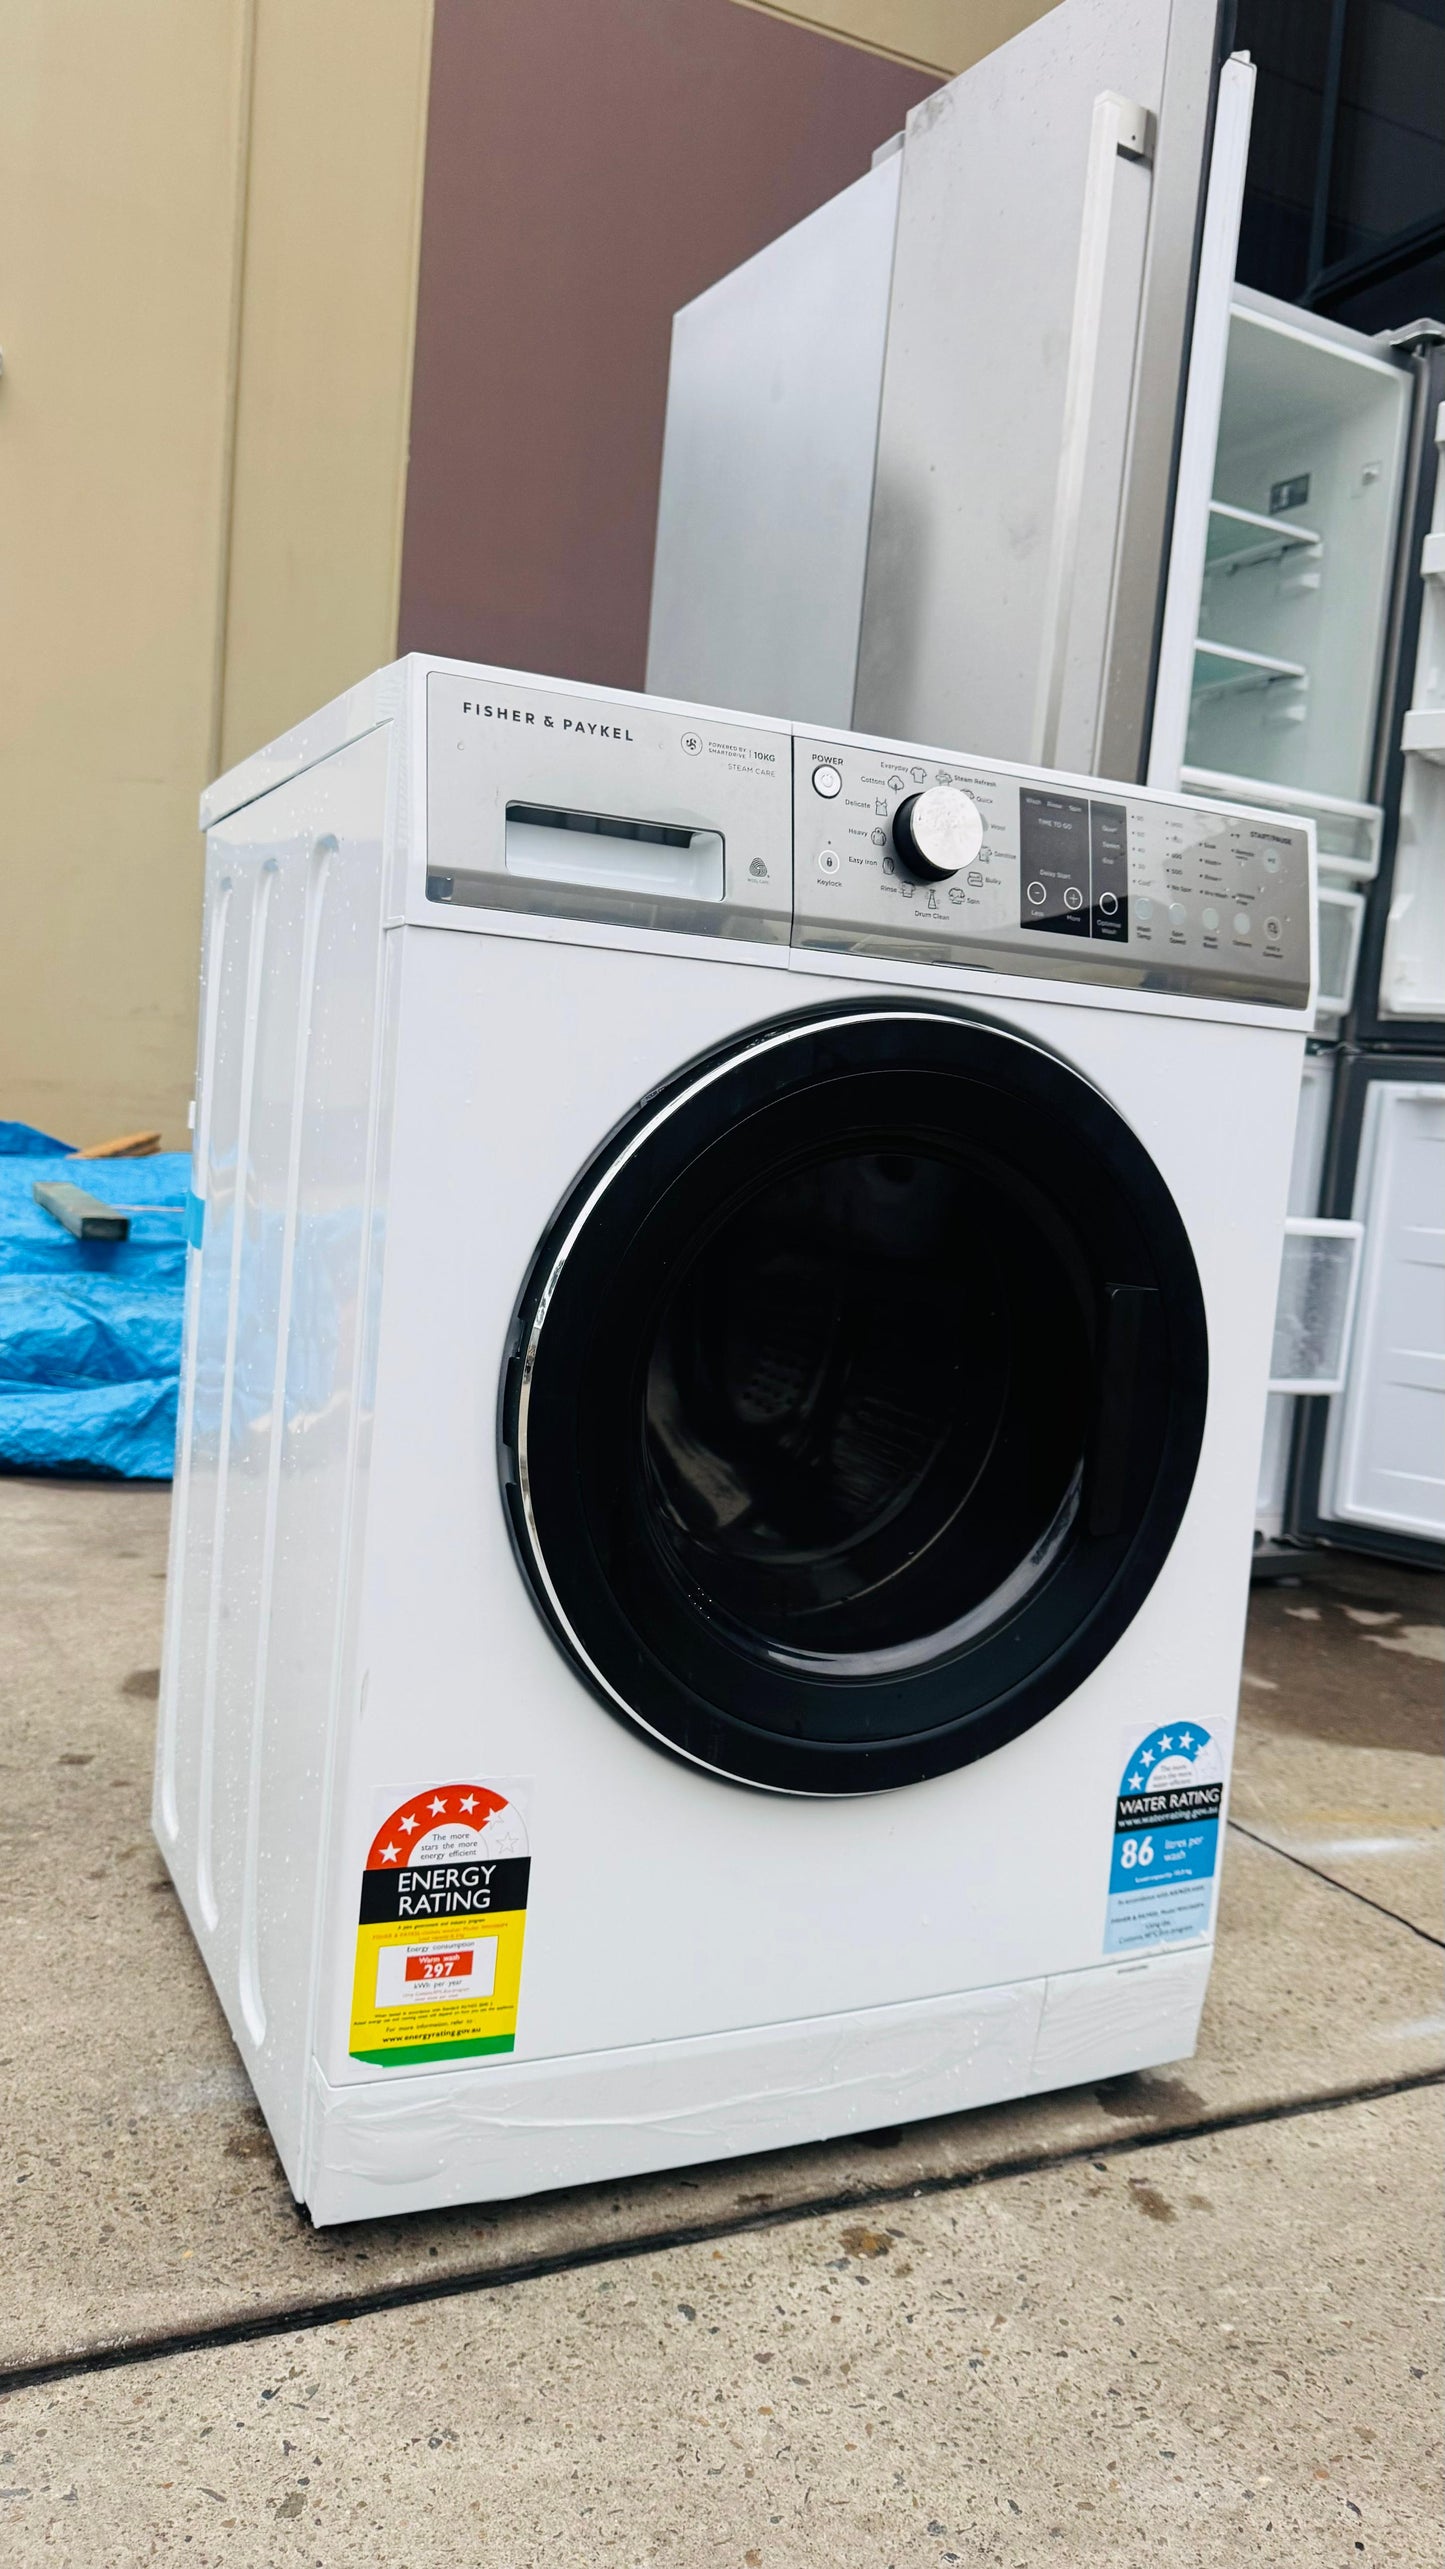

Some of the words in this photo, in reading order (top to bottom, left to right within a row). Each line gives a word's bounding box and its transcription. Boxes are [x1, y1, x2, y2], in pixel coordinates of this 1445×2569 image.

[463, 702, 535, 725] FISHER
[543, 716, 554, 728] &
[563, 719, 633, 741] PAYKEL
[708, 741, 738, 752] POWERED
[708, 748, 746, 759] SMARTDRIVE
[754, 751, 775, 762] 10KG
[812, 753, 844, 766] POWER
[728, 763, 753, 774] STEAM
[755, 768, 776, 778] CARE
[880, 761, 909, 773] Everyday
[860, 776, 885, 786] Cottons
[954, 774, 973, 784] Steam
[974, 778, 996, 788] Refresh
[845, 799, 871, 809] Delicate
[1053, 820, 1062, 828] TO
[1062, 822, 1072, 830] GO
[848, 828, 868, 837] Heavy
[848, 856, 864, 865] Easy
[817, 878, 842, 887] Keylock
[880, 885, 898, 893] Rinse
[966, 897, 981, 905] Spin
[914, 910, 932, 919] Drum
[933, 912, 950, 921] Clean
[1119, 1795, 1167, 1815] WATER
[1169, 1788, 1220, 1808] RATING
[1118, 1806, 1218, 1827] www.waterrating.gov.au
[433, 1833, 446, 1841] The
[421, 1843, 438, 1851] stars
[442, 1841, 454, 1849] the
[458, 1840, 478, 1848] more
[420, 1851, 445, 1860] energy
[449, 1849, 477, 1858] efficient
[1120, 1836, 1154, 1869] 86
[1188, 1836, 1204, 1848] per
[1163, 1849, 1186, 1861] wash
[398, 1864, 497, 1892] ENERGY
[398, 1889, 491, 1916] RATING
[406, 1943, 429, 1953] Energy
[432, 1941, 475, 1950] consumption
[419, 1955, 440, 1964] Warm
[443, 1954, 461, 1962] wash
[423, 1962, 454, 1979] 297
[414, 1981, 430, 1989] kWh
[434, 1981, 445, 1989] per
[449, 1979, 462, 1987] year
[382, 2028, 481, 2043] www.energyrating.gov.au
